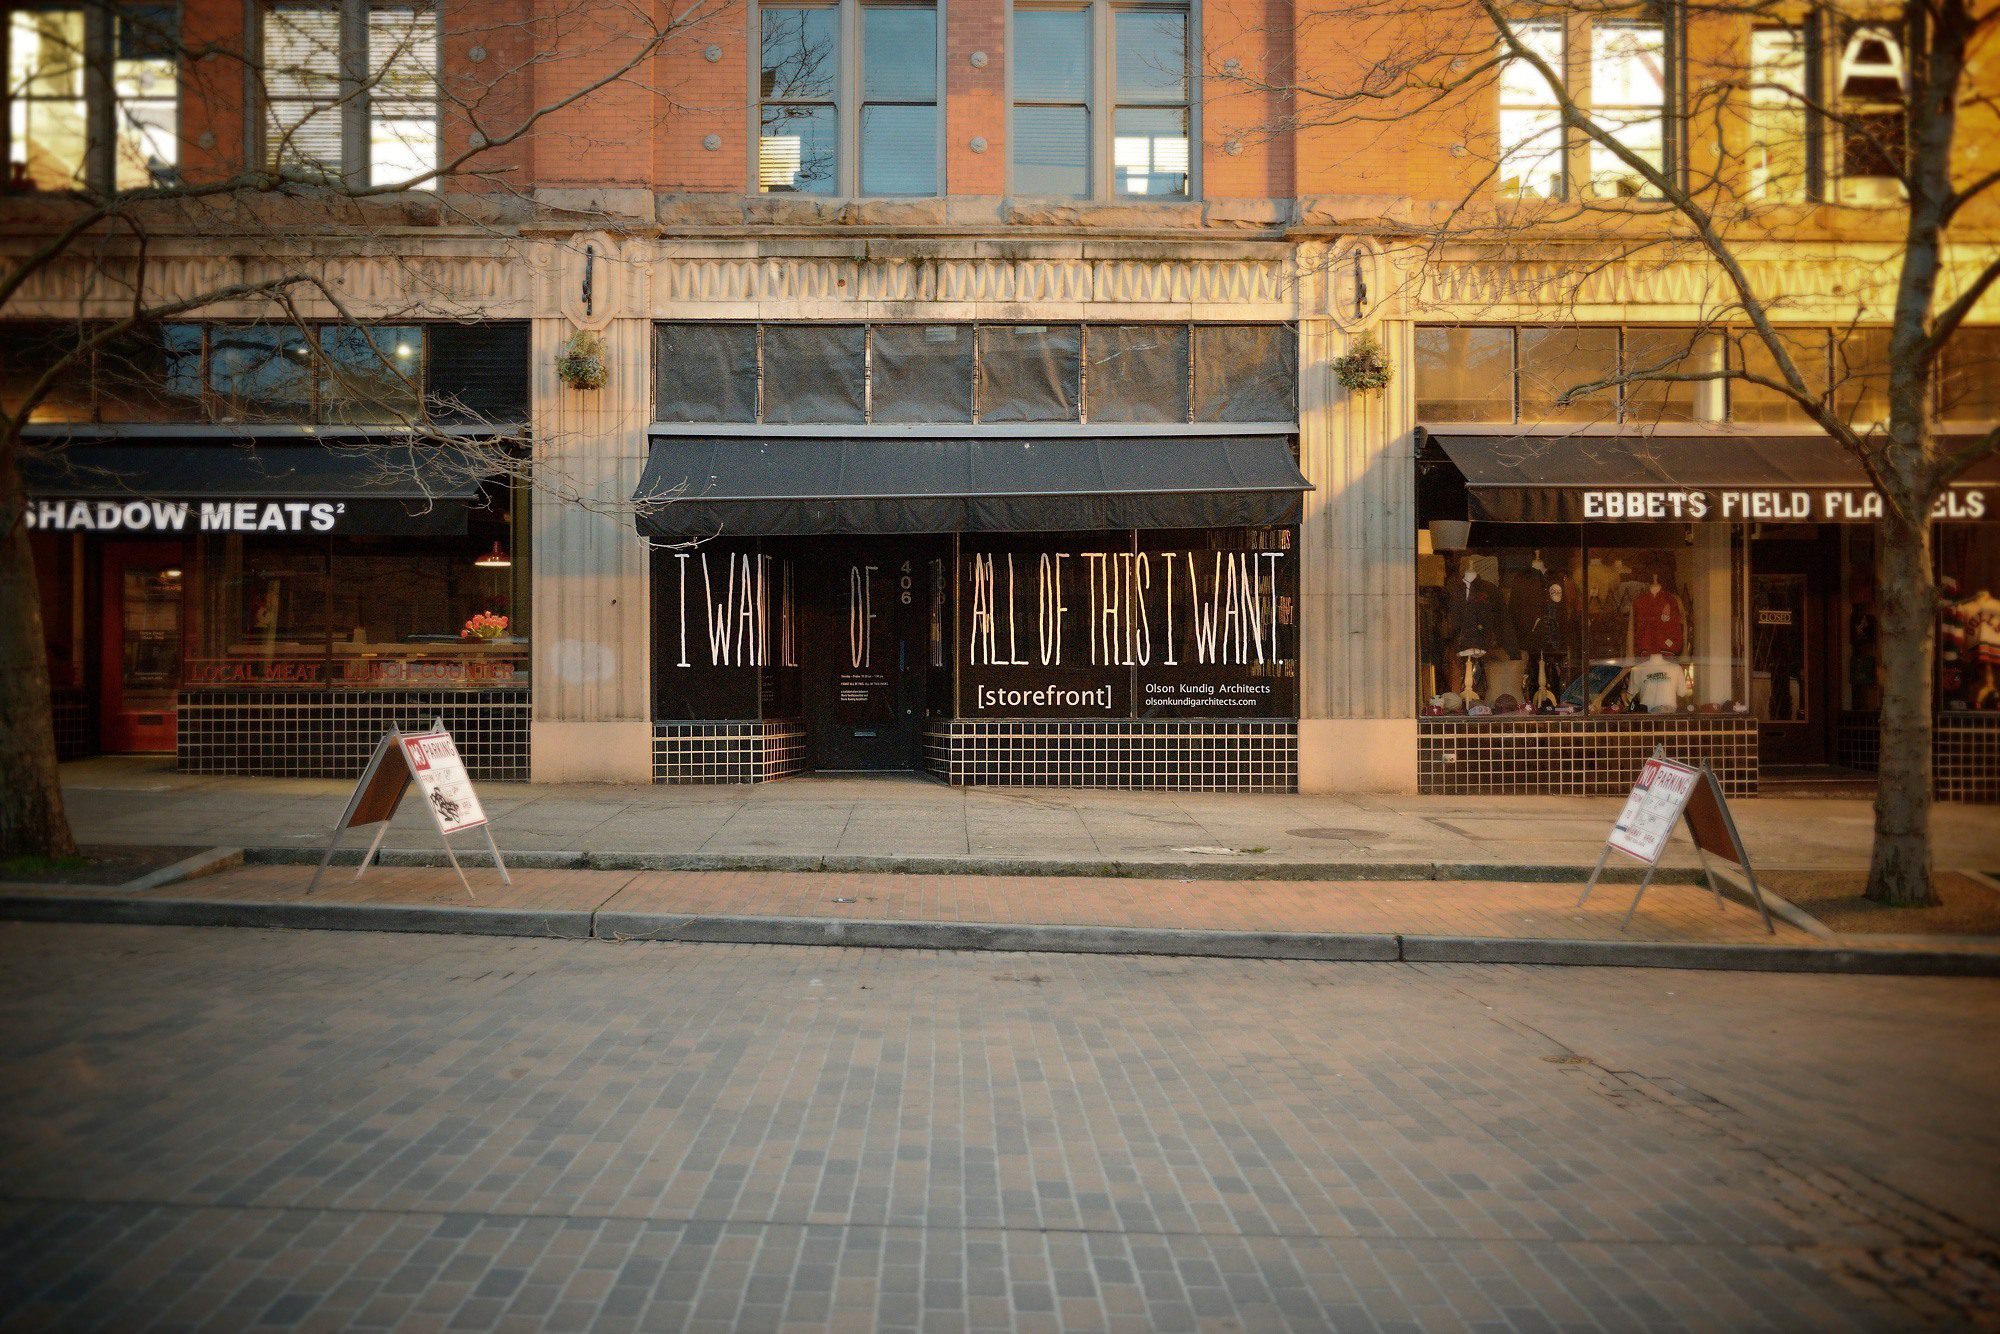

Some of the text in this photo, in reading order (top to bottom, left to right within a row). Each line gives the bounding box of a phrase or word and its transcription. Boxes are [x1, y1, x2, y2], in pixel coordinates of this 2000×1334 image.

[1583, 491, 1985, 518] EBBETS FIELD FLAELS
[850, 566, 878, 668] OF
[970, 552, 1029, 666] ALL
[1039, 552, 1070, 666] OF
[1080, 551, 1151, 667] THIS
[1161, 552, 1178, 666] I
[1759, 612, 1792, 623] CLOSED
[191, 664, 320, 682] LOCAL MEAT
[344, 663, 515, 680] LUNCH COUNTER
[1145, 683, 1271, 695] Olson Kundig Architects
[1145, 697, 1257, 707] olsonkundigarchitects.com
[423, 741, 456, 760] PARKING
[1636, 765, 1689, 793] NO PARKING
